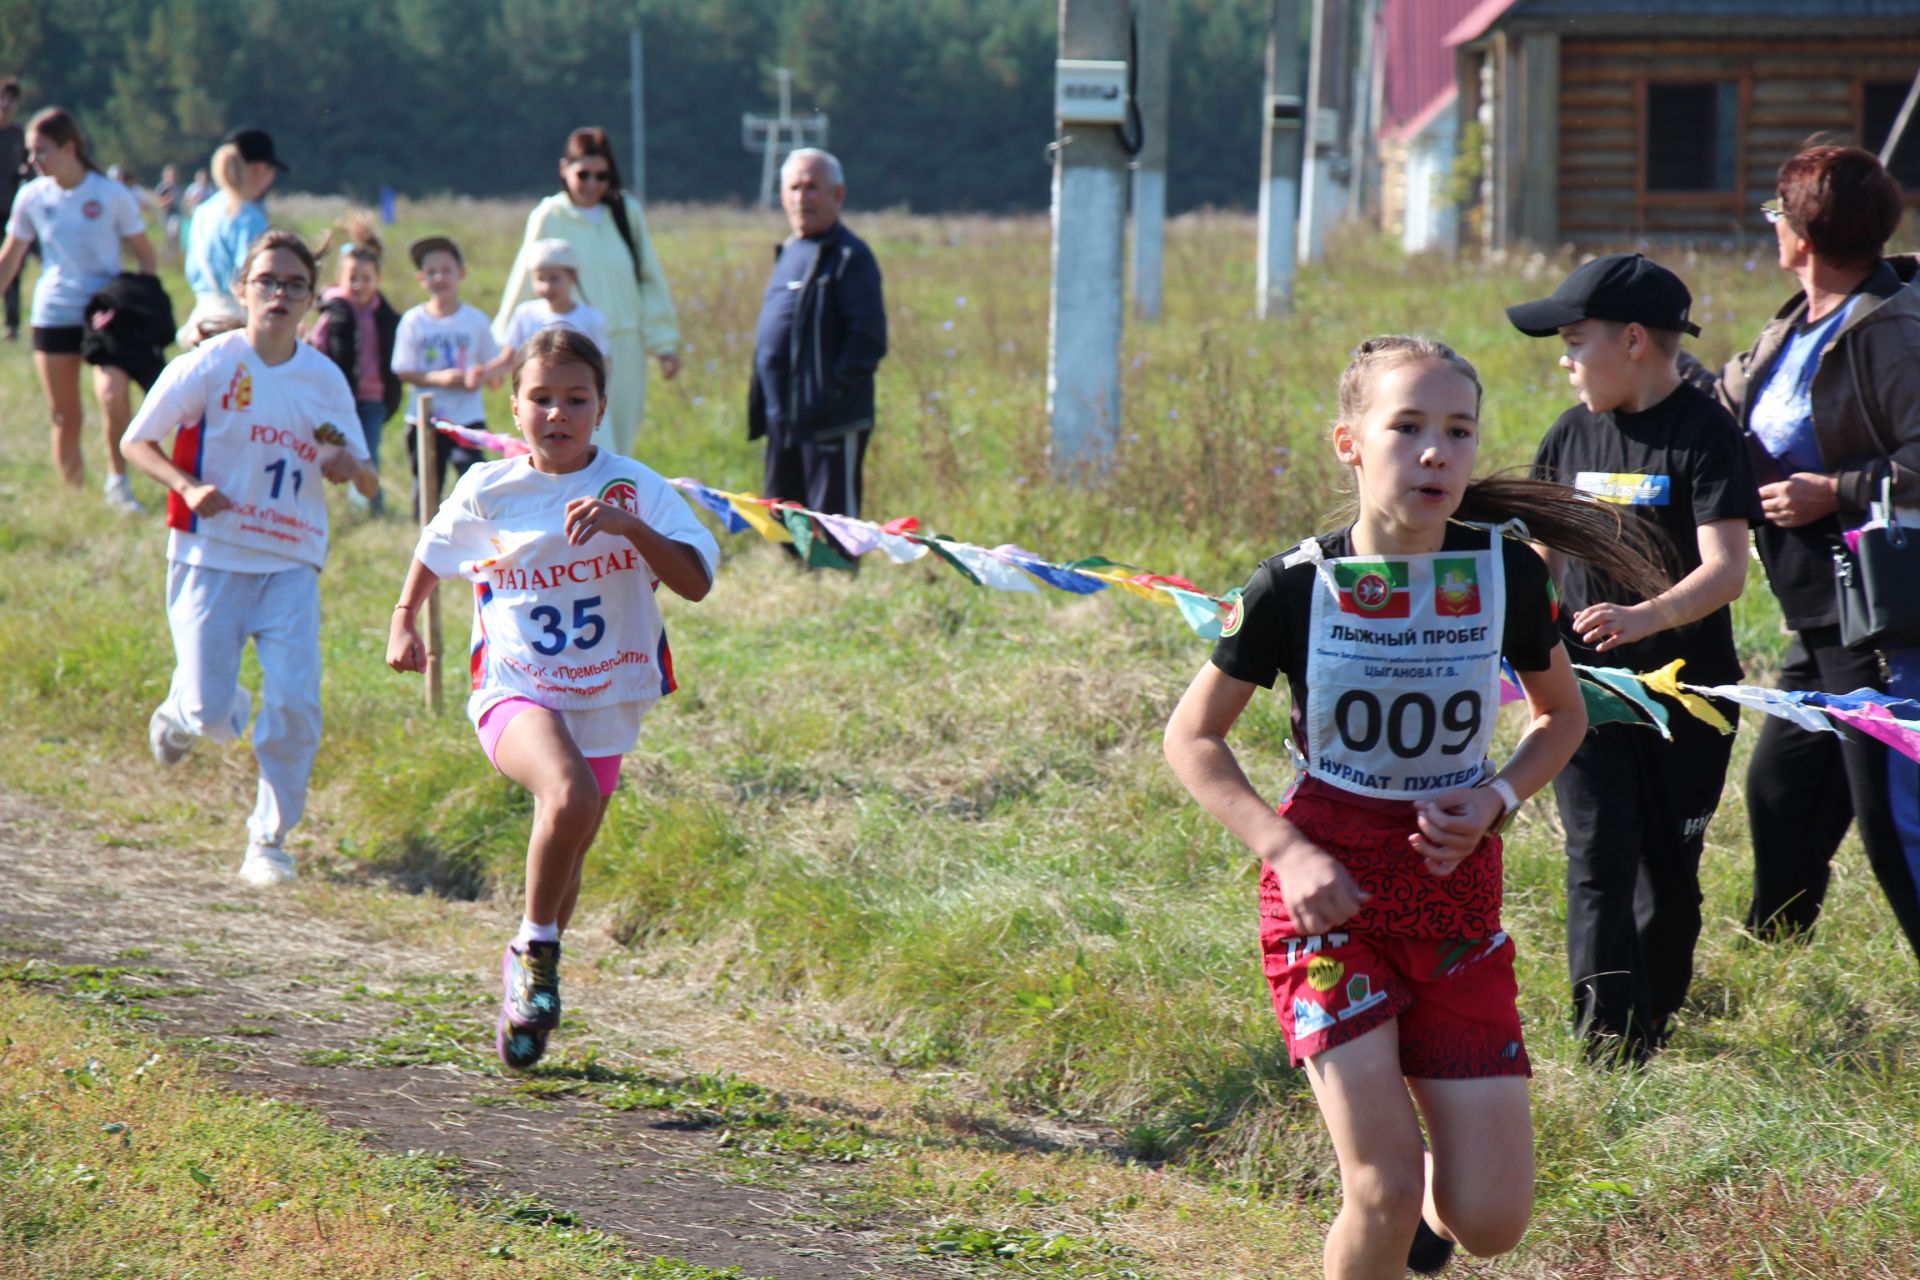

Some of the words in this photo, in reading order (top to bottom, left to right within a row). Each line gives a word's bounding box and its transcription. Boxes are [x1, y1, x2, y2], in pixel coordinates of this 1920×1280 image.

[530, 595, 605, 656] 35
[1330, 625, 1417, 646] ЛЫЖНЫЙ
[1423, 626, 1488, 644] ПРОБЕГ
[1364, 665, 1433, 679] ЦЫГАНОВА
[1437, 665, 1459, 678] Г.В.
[1335, 689, 1482, 759] 009
[1319, 757, 1392, 789] НУРЛАТ
